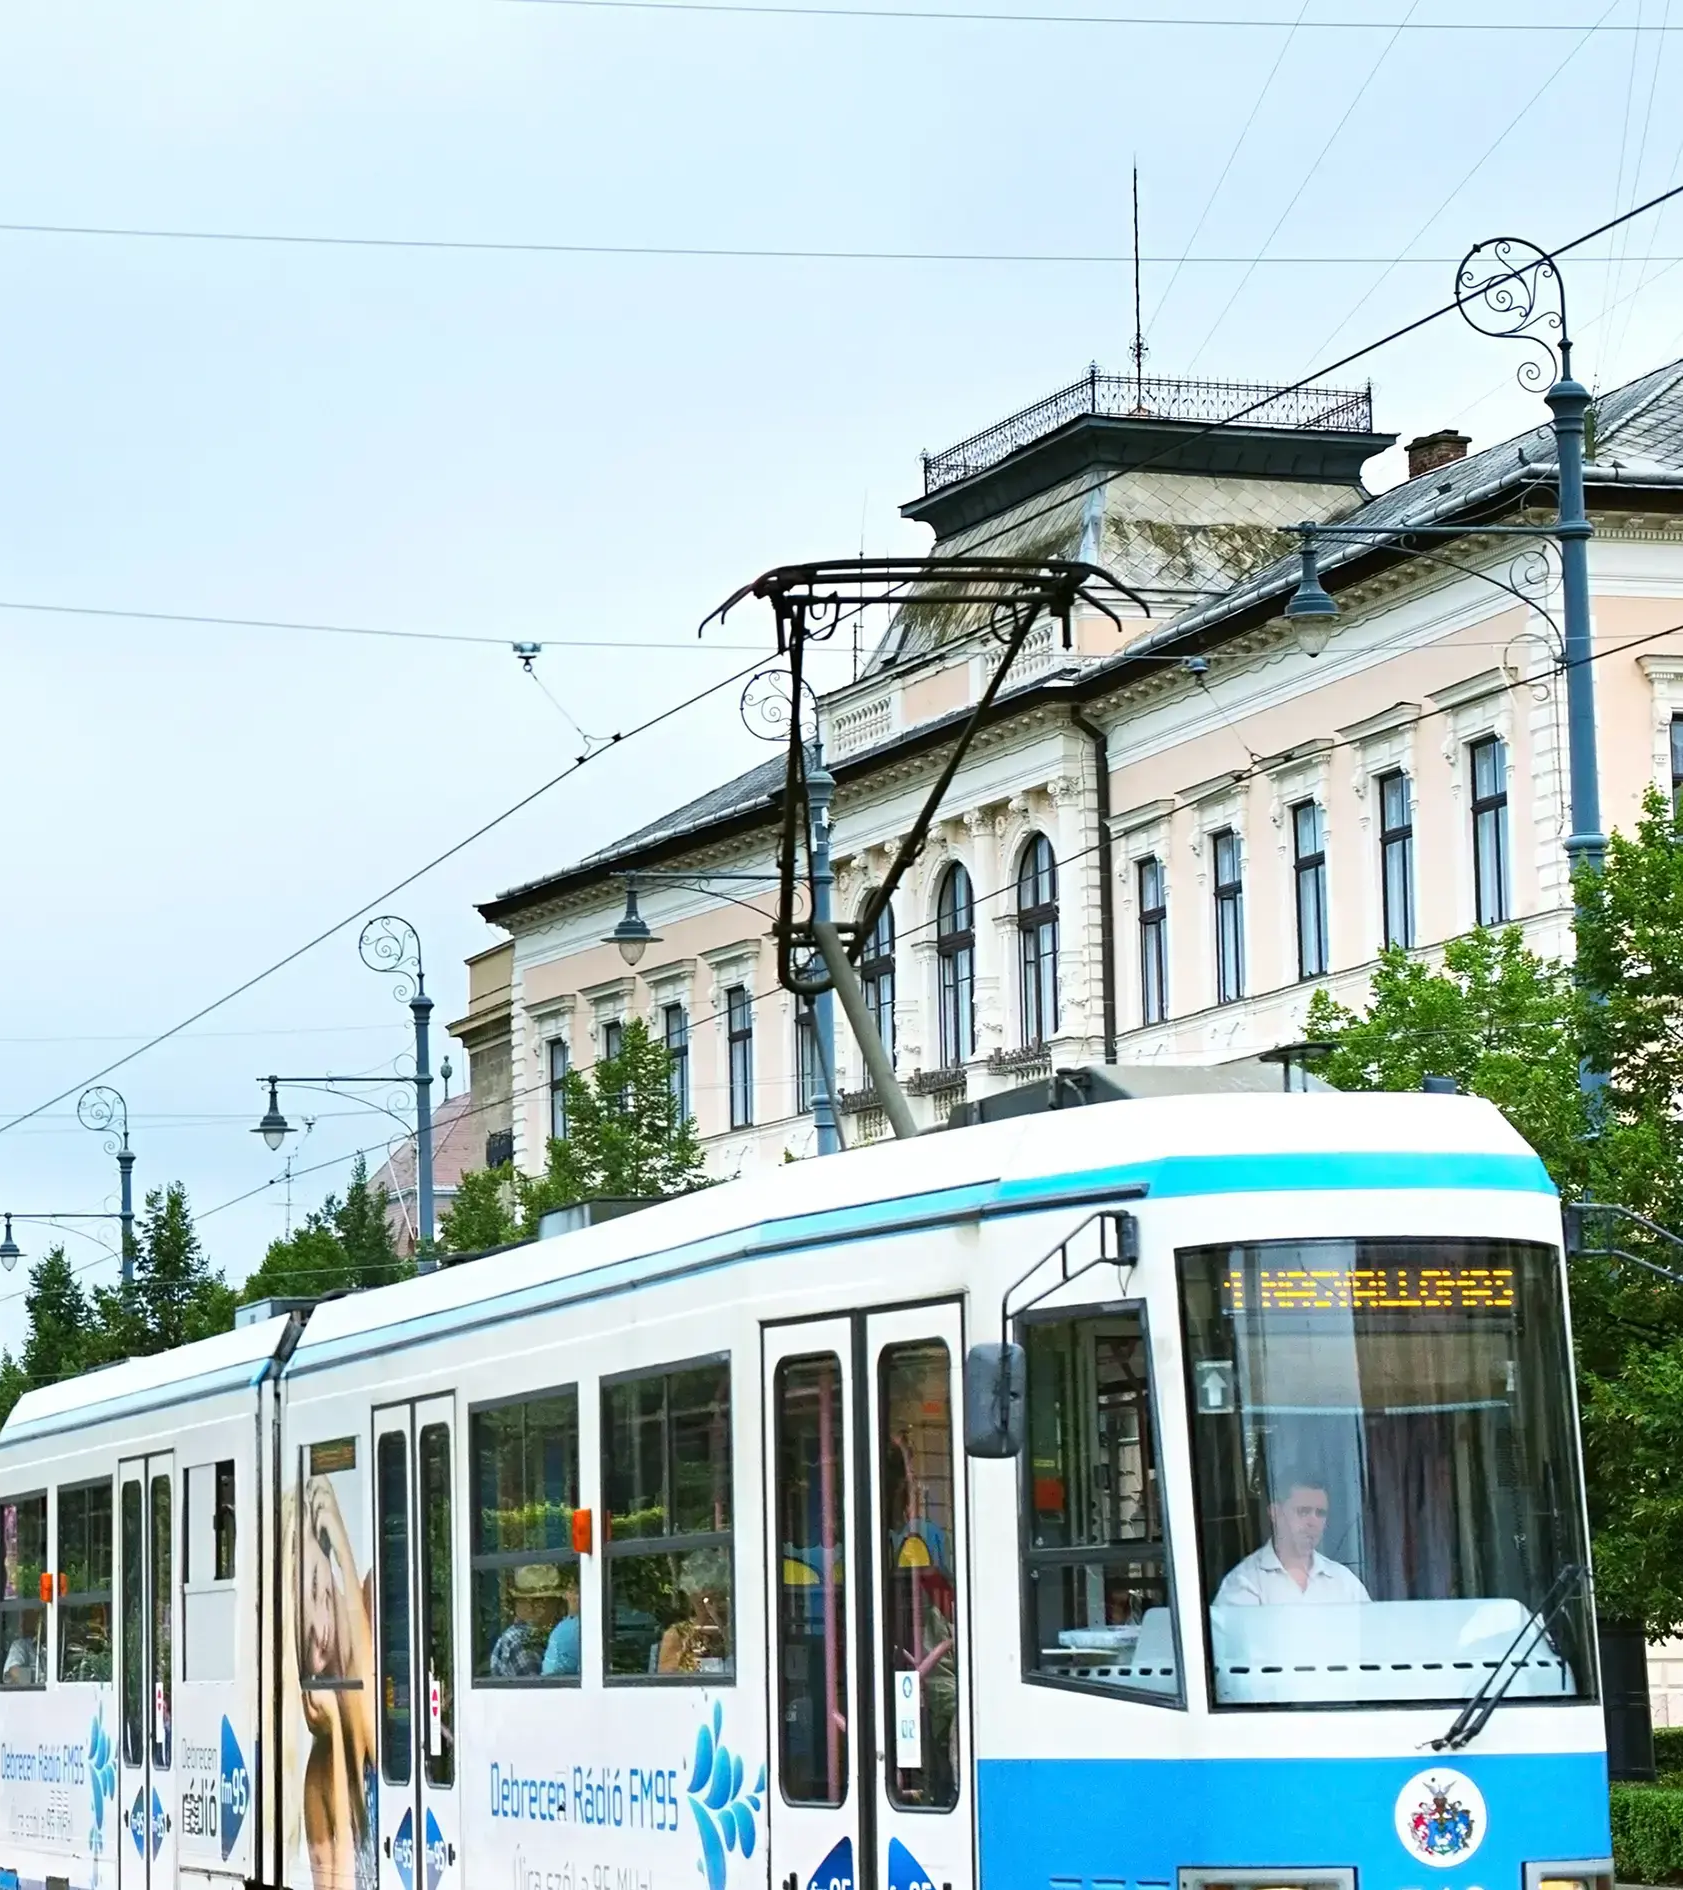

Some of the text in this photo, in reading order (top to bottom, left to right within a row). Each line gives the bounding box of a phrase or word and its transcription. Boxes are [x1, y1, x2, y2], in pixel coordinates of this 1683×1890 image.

[1, 1741, 37, 1781] Debrecen
[490, 1761, 679, 1832] Debrecen Rádió FM95
